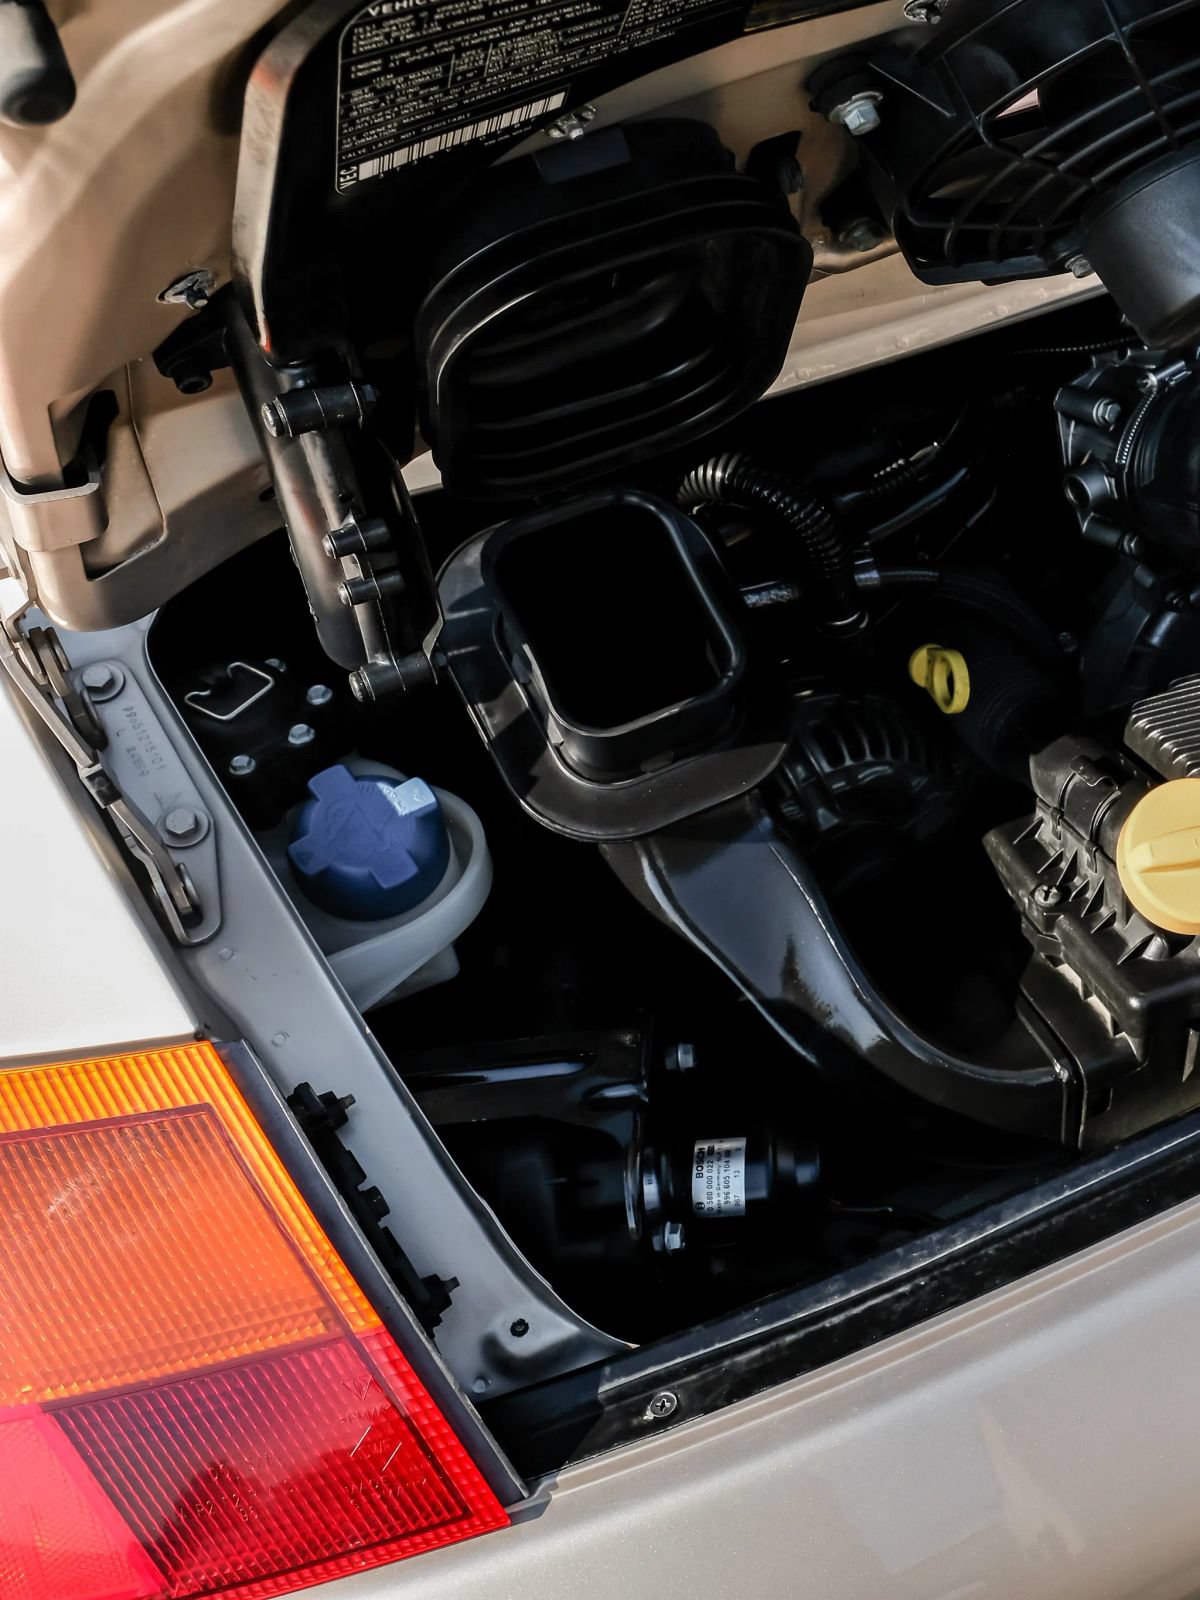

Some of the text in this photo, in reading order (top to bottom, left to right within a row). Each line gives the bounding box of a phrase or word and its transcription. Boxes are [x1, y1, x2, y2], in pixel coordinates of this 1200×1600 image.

[493, 4, 528, 16] SYSTEM
[531, 3, 590, 21] ADJUSTMENTS
[565, 6, 600, 18] NEUTRAL
[402, 111, 435, 124] MANUAL
[463, 87, 506, 104] WARRANTY
[510, 68, 564, 88] MAINTENANCE
[421, 113, 471, 132] ADJUSTABLE
[340, 166, 357, 189] VEC
[696, 1147, 706, 1179] BOSCH
[734, 1170, 740, 1178] 13
